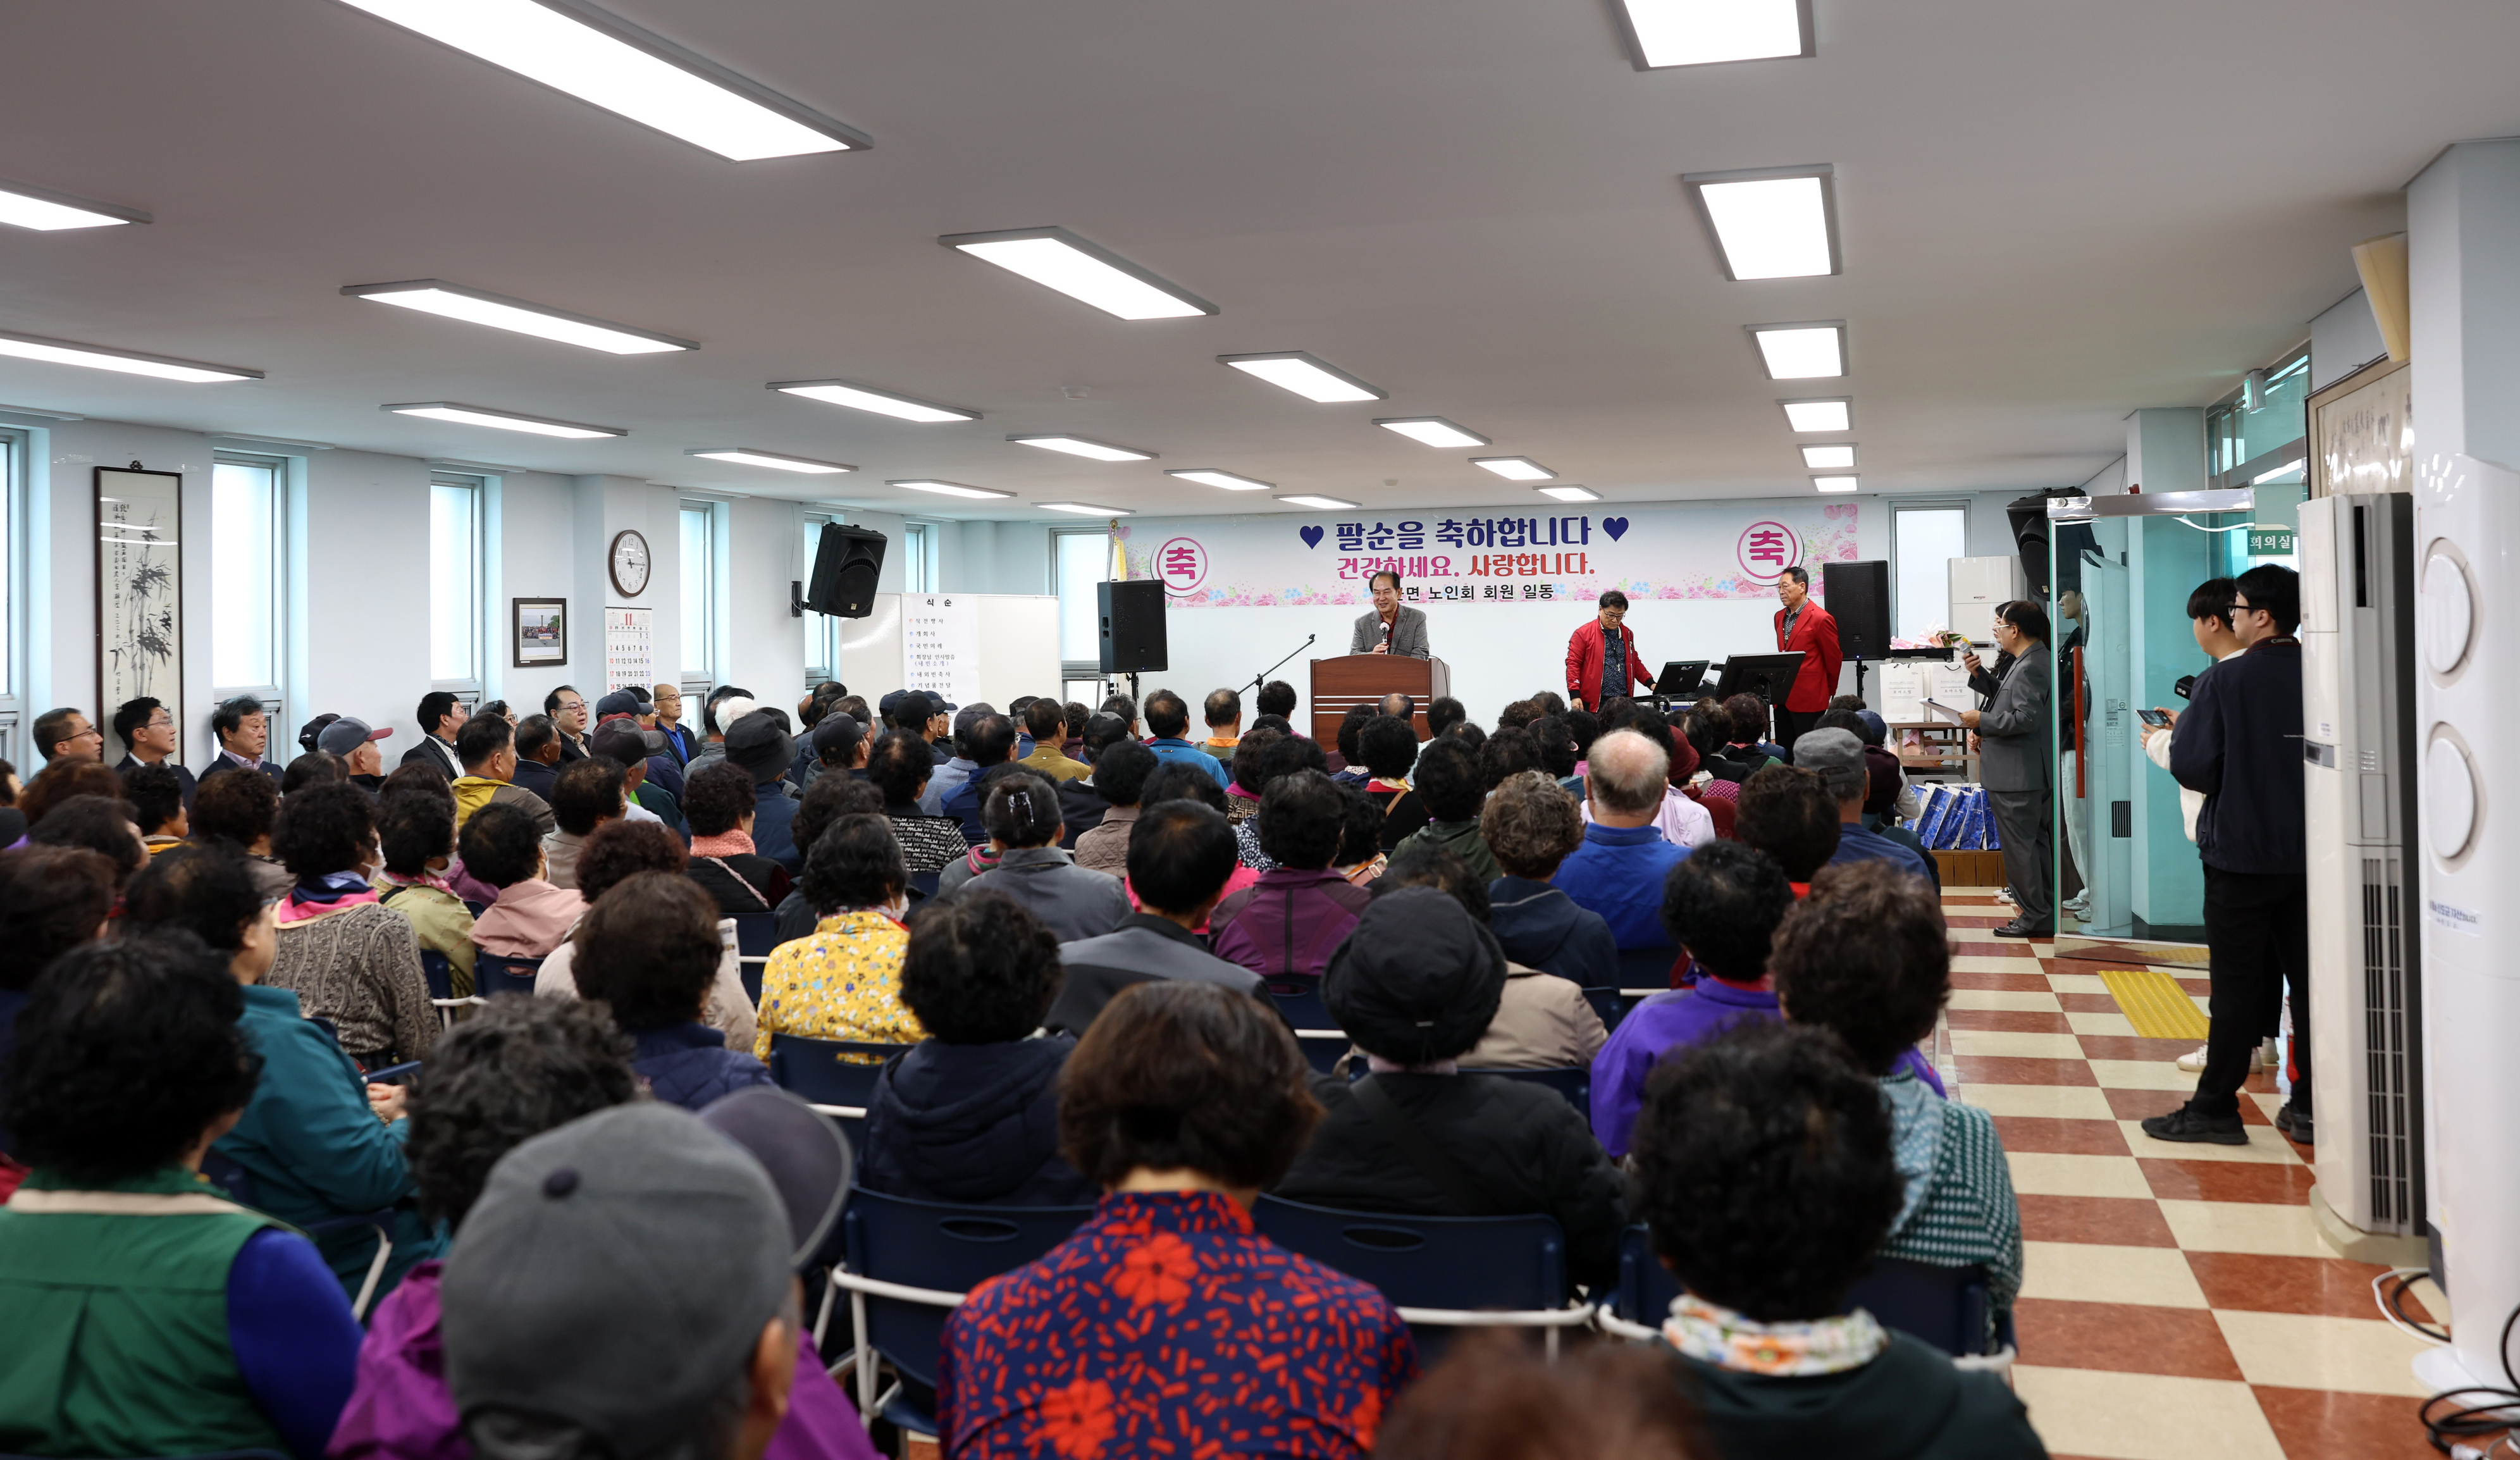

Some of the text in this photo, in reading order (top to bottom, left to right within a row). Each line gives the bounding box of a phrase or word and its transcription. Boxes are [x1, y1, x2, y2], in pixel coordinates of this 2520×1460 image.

[1336, 516, 1592, 551] 팔순을 축하합니다
[2249, 535, 2290, 550] 회의실
[1748, 530, 1785, 566] 축
[1165, 547, 1197, 579] 축
[1337, 552, 1595, 579] 건강하세요. 사랑합니다.
[1428, 585, 1474, 600] 노인회
[1483, 585, 1514, 600] 회원
[1522, 584, 1554, 599] 일동
[625, 613, 632, 626] 11
